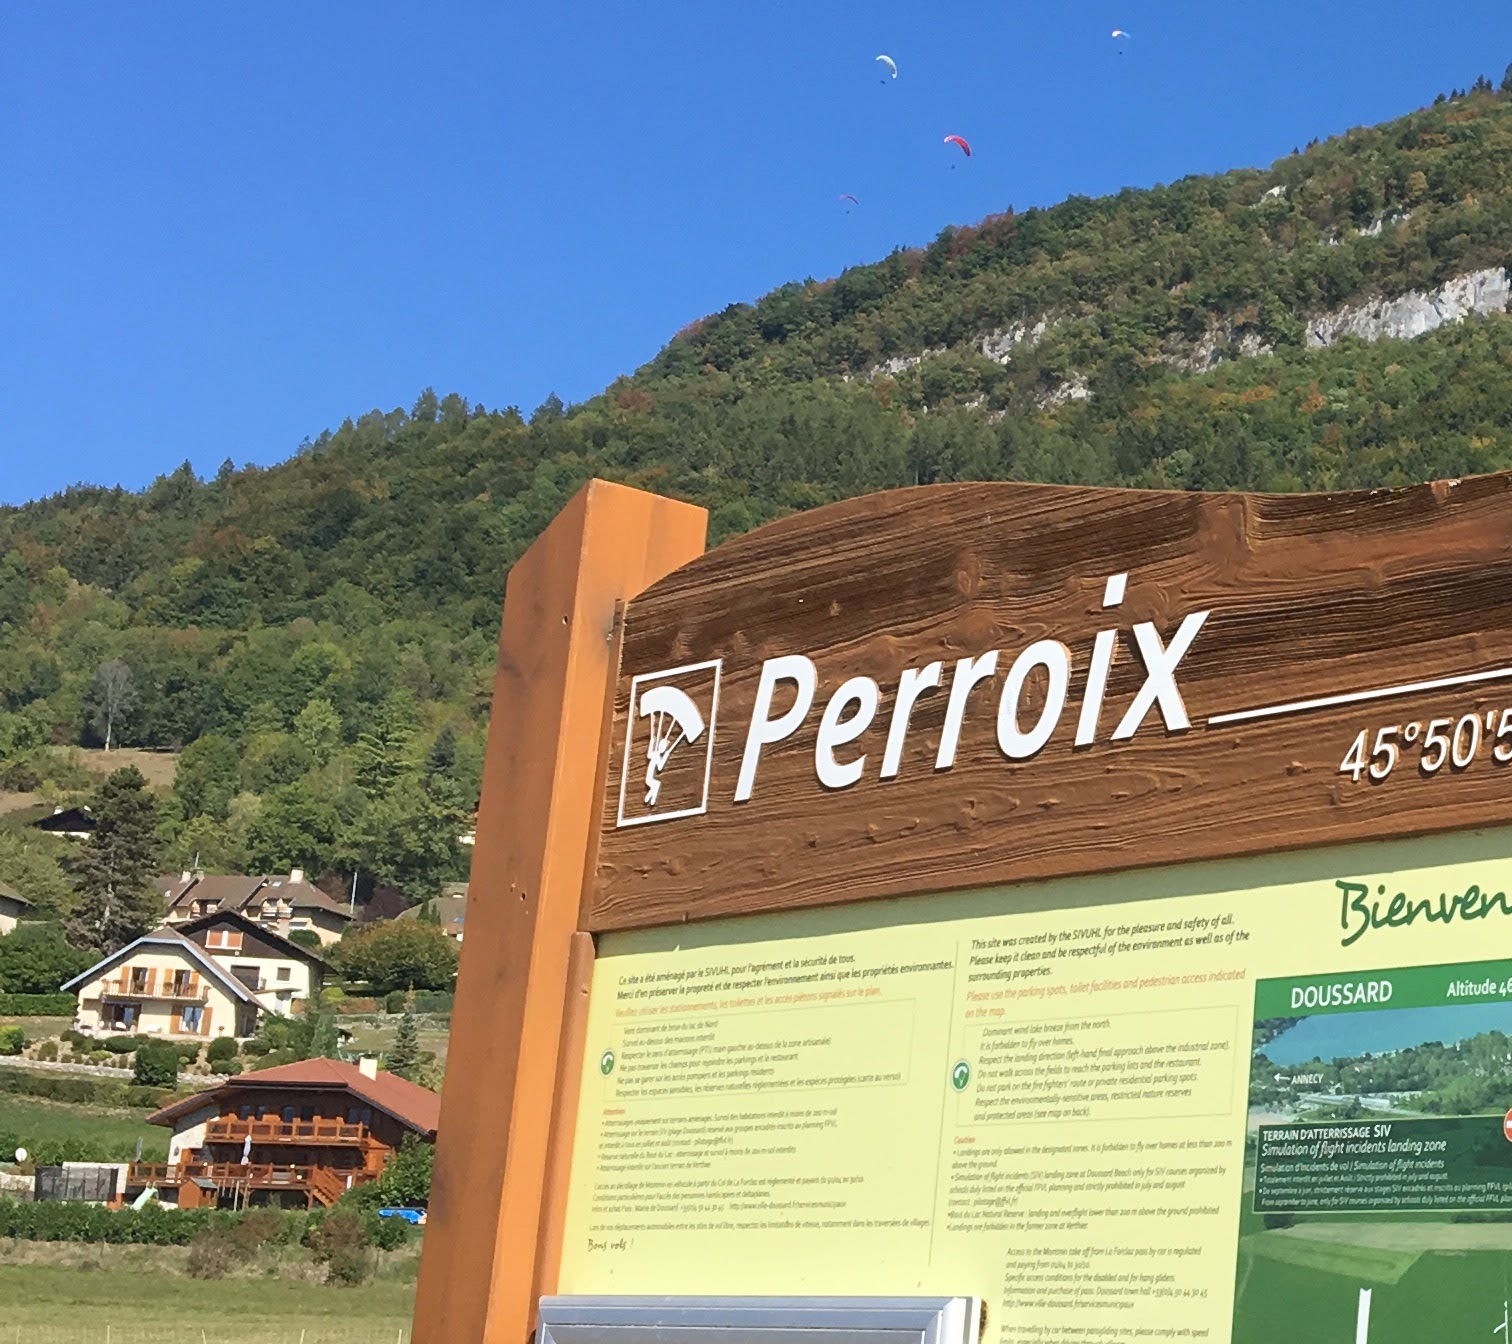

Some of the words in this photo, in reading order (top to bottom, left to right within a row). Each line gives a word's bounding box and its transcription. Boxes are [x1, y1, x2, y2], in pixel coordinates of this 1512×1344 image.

[735, 572, 1210, 802] Perroix
[1291, 981, 1392, 1008] DOUSSARD
[1447, 978, 1497, 997] Altitude
[1291, 1073, 1324, 1085] ANNECY
[1263, 1130, 1299, 1141] TERRAIN
[1301, 1127, 1371, 1140] D'ATTERRISSAGE
[1373, 1125, 1391, 1138] SIV
[1261, 1143, 1308, 1156] Simulation
[1309, 1141, 1322, 1159] of
[1321, 1141, 1344, 1159] flight
[1346, 1141, 1386, 1153] incidents
[1387, 1139, 1422, 1155] landing
[1424, 1141, 1447, 1151] zone
